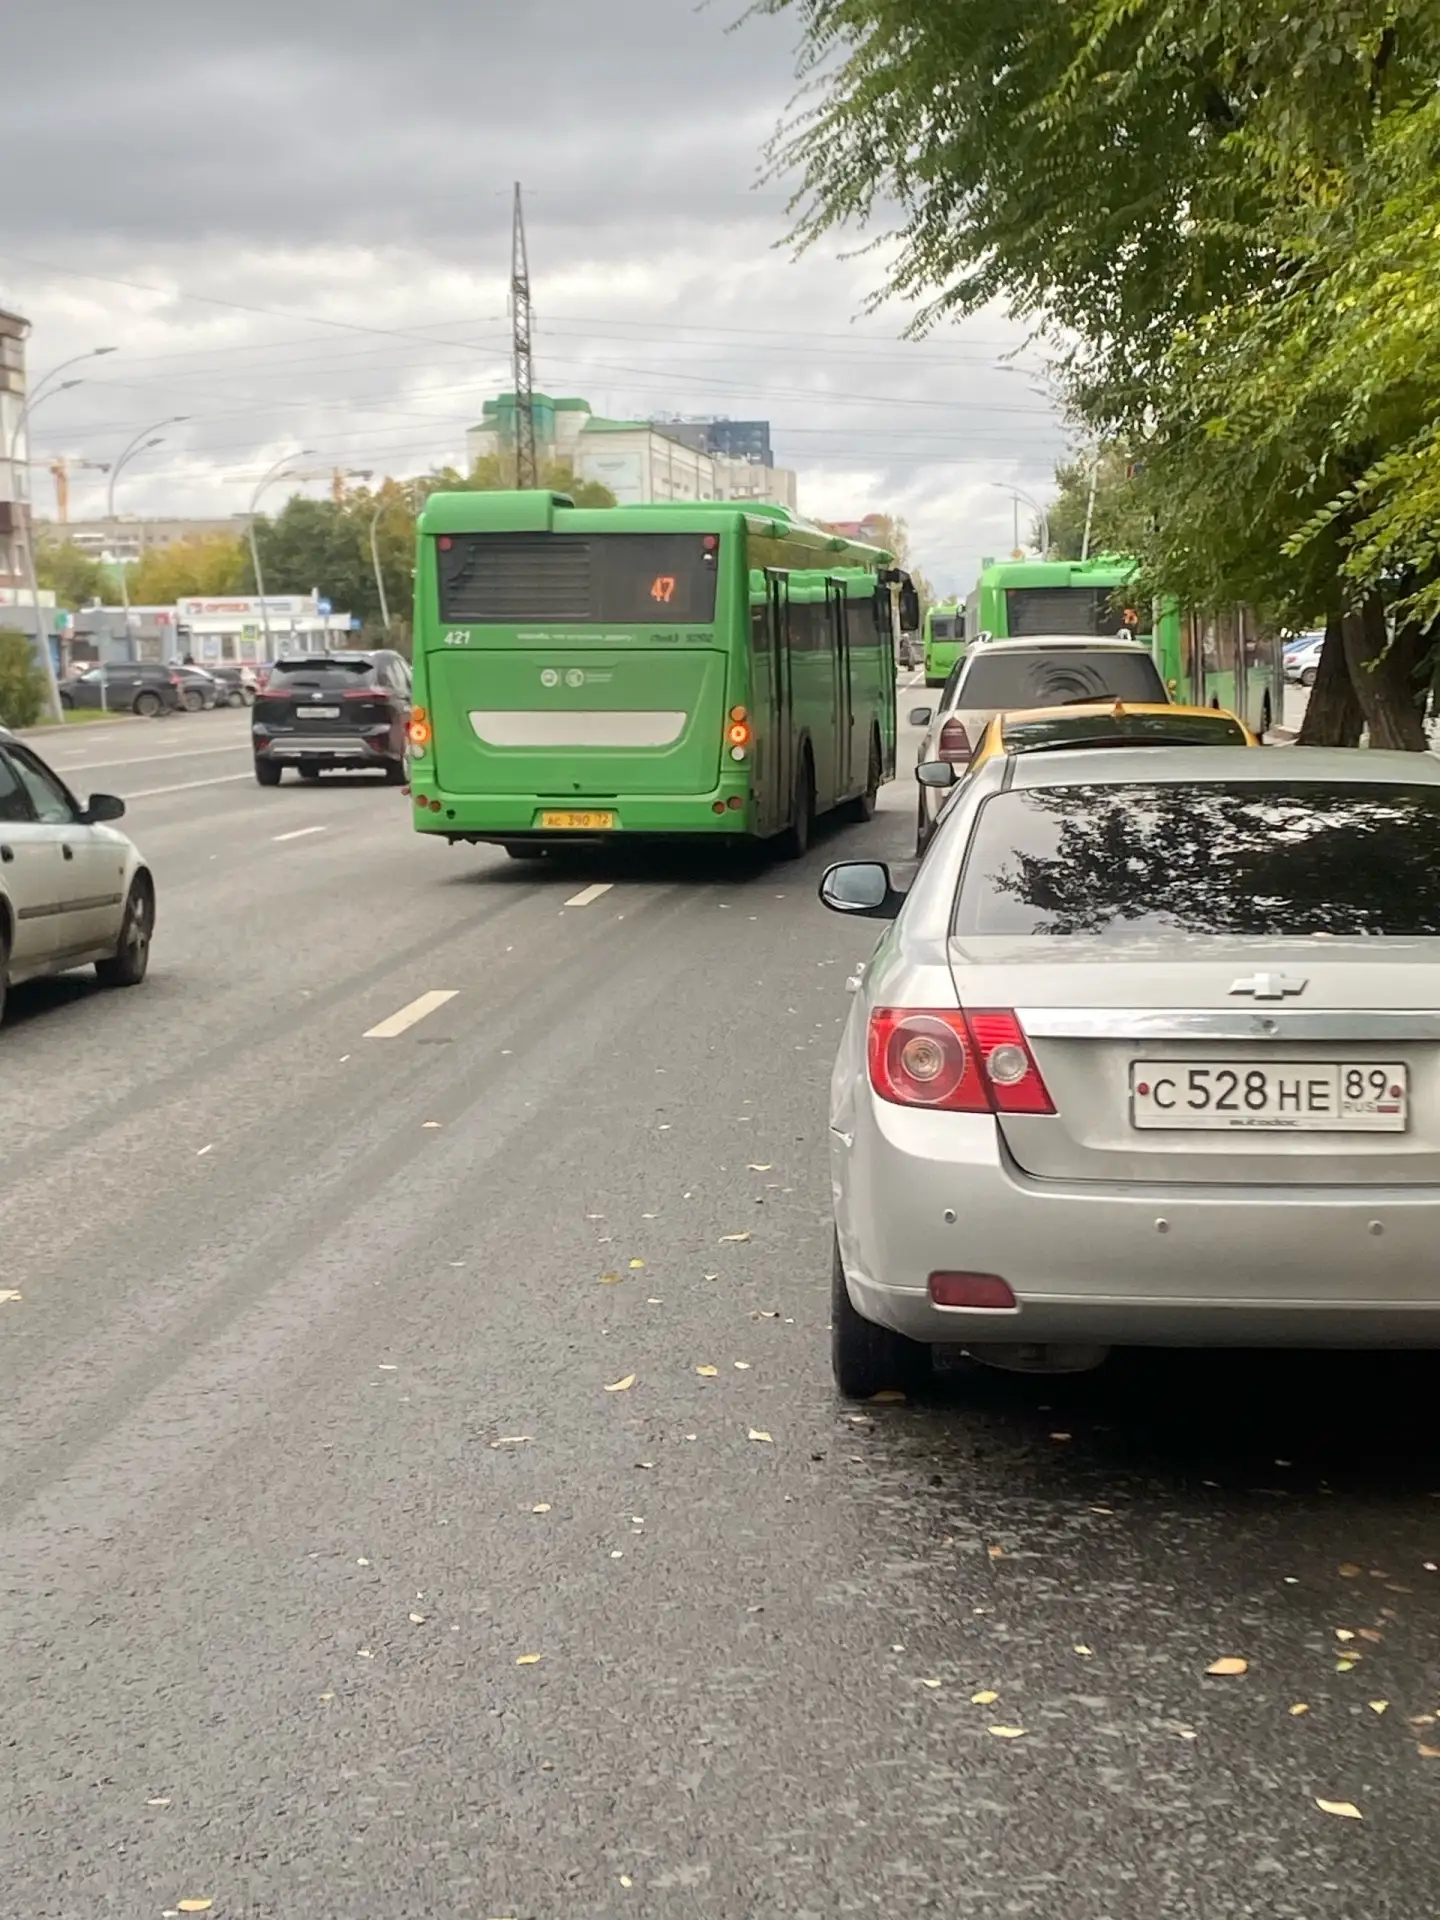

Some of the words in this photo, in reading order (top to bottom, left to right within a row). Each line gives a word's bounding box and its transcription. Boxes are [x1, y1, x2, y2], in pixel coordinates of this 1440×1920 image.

[650, 576, 675, 602] 47
[444, 631, 470, 645] 421
[1346, 1069, 1387, 1100] 89
[1343, 1101, 1376, 1112] RUS
